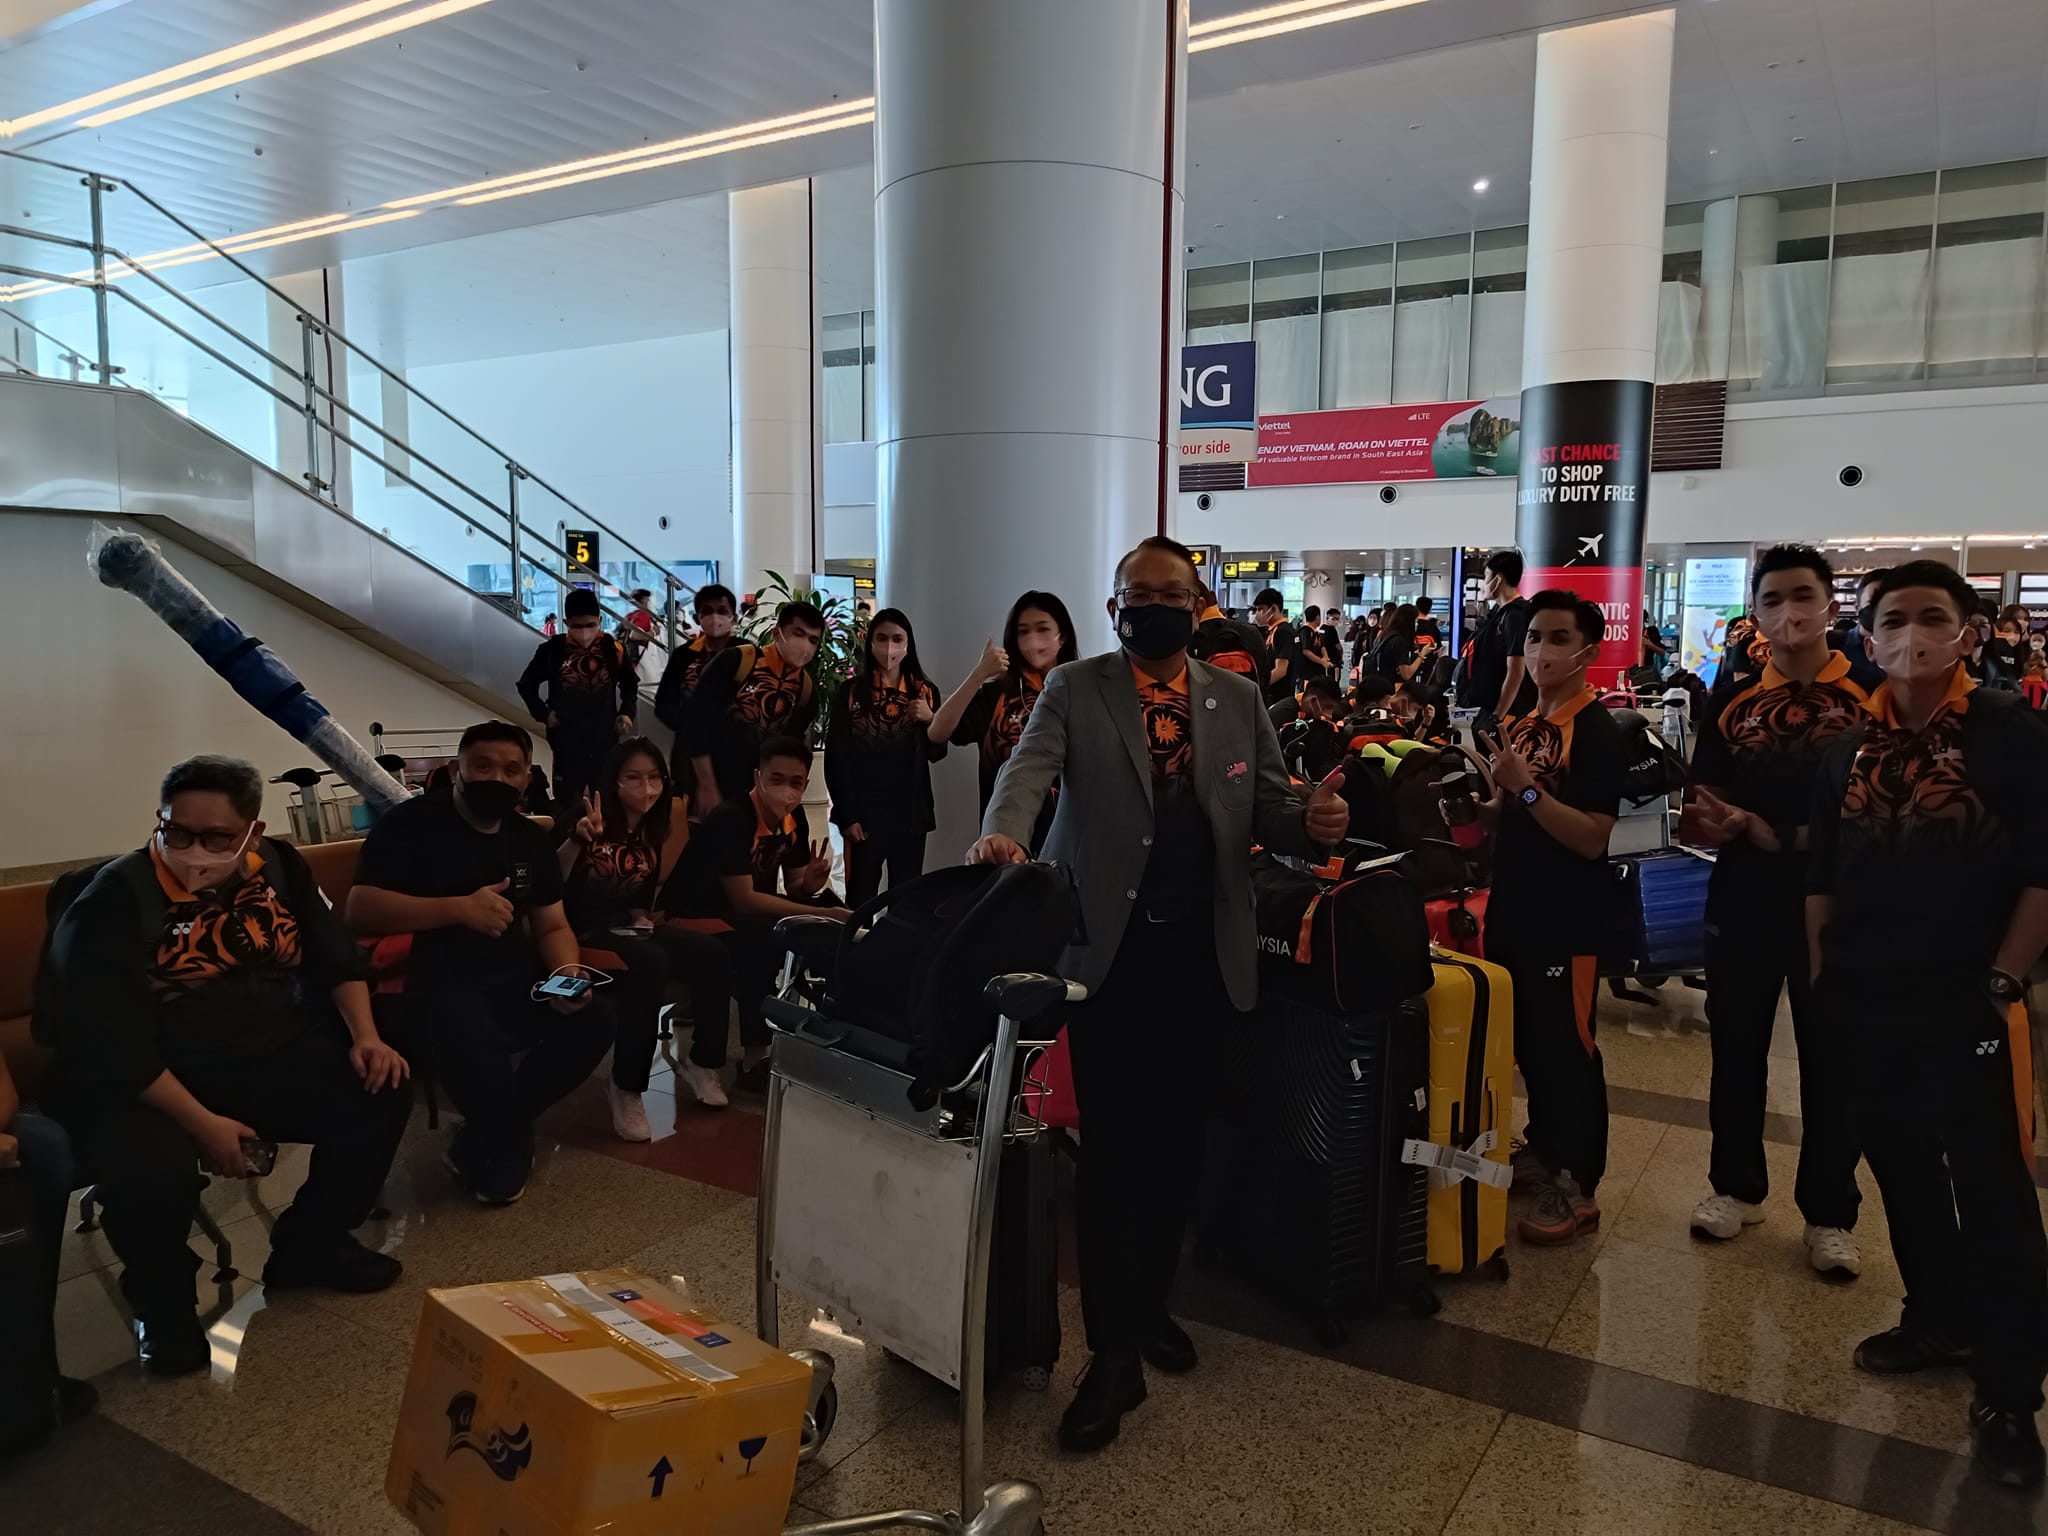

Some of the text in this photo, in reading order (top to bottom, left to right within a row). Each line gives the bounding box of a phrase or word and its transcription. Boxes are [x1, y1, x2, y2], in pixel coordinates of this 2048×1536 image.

[1417, 412, 1431, 421] LTE
[1180, 440, 1231, 455] our side
[1258, 437, 1429, 455] ENJOY VIETNAM, ROAM ON VIETTEL
[1561, 443, 1621, 462] CHANCE
[1268, 455, 1298, 463] valuable
[1299, 454, 1329, 462] telecom
[1330, 452, 1351, 460] brand
[1361, 451, 1385, 459] South
[1405, 449, 1424, 457] Asia
[1541, 464, 1604, 483] TO SHOP
[1518, 485, 1636, 506] LUXURY DUTY FREE
[576, 541, 590, 564] 5
